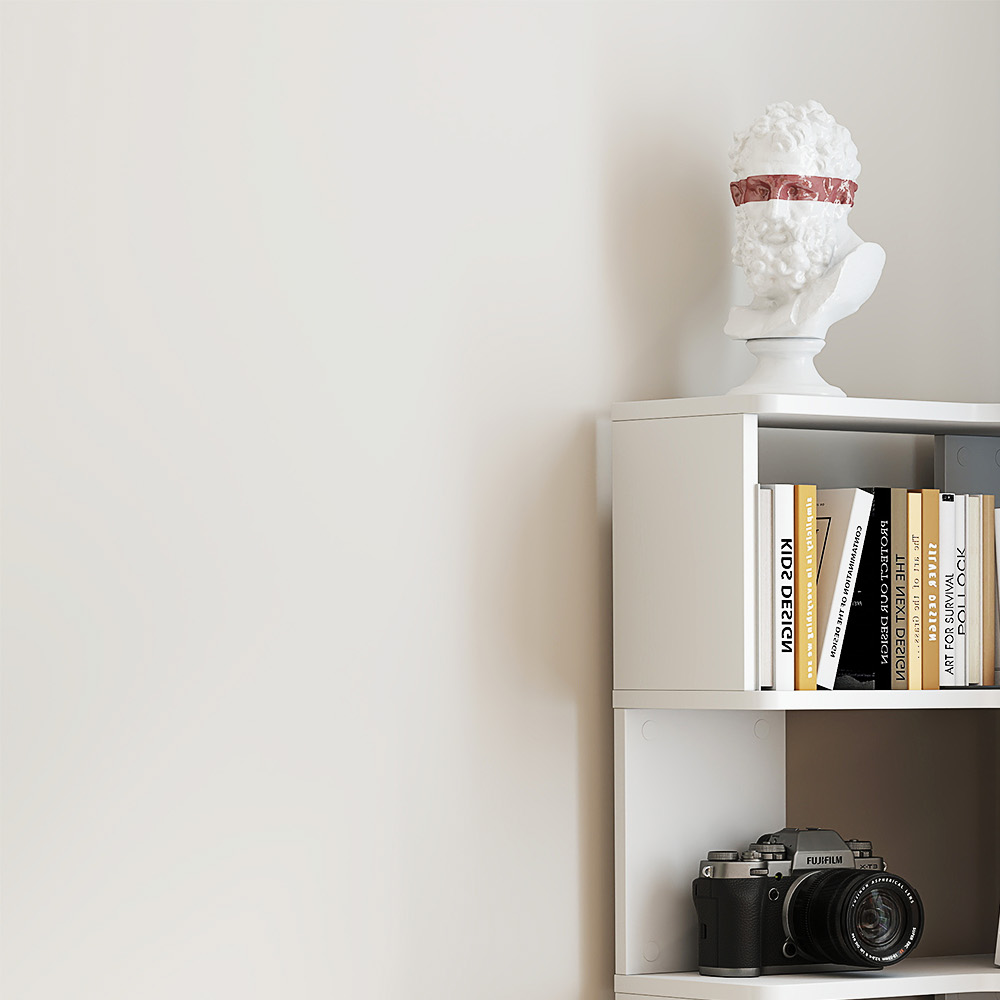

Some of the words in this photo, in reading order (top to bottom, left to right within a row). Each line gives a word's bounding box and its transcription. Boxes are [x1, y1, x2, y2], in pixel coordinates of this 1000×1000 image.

[944, 573, 954, 624] SURVIVAL
[944, 628, 954, 650] FOR
[944, 654, 954, 676] ART
[806, 856, 842, 864] FUJIFILM
